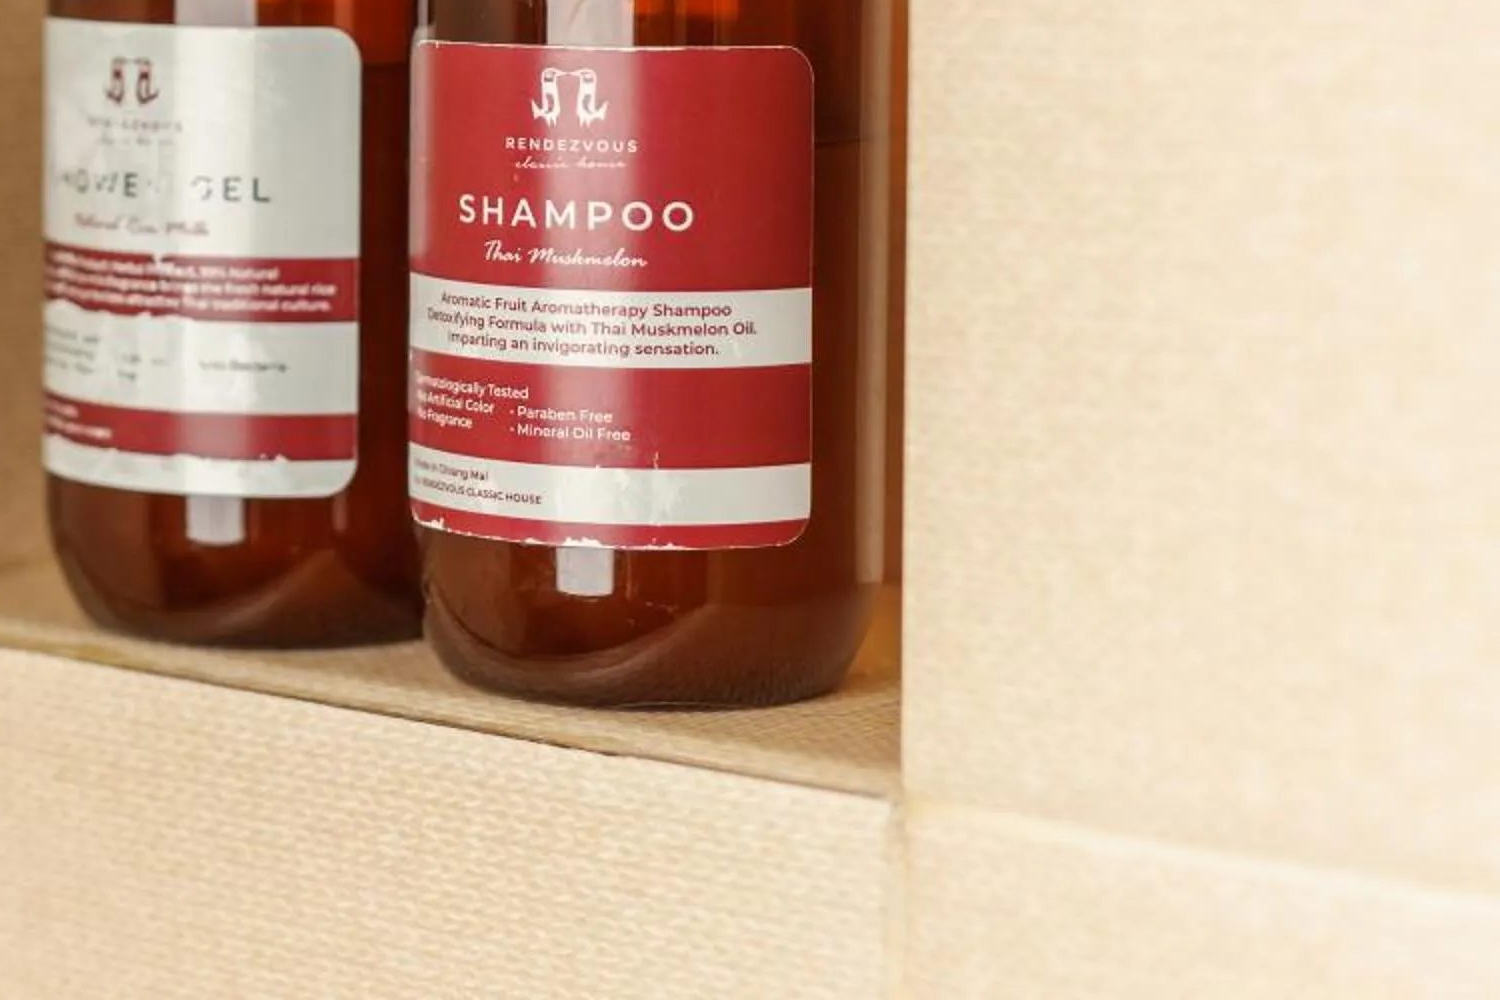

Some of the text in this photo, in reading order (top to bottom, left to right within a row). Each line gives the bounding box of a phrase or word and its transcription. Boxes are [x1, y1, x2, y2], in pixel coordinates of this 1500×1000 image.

[505, 136, 638, 153] RENDEZVOUS
[459, 193, 695, 232] SHAMPOO
[484, 239, 648, 268] Thai Muskmelon
[261, 284, 309, 297] natural
[442, 290, 732, 319] Aromatic Fruit Aromatherapy Shampoo
[427, 307, 758, 336] Detoxifying Formula with Thai Muskmelon Oil.
[510, 339, 529, 351] an
[533, 338, 630, 358] invigorating
[635, 341, 720, 356] sensation.
[487, 383, 530, 400] Tested
[465, 399, 495, 414] Color
[516, 405, 613, 423] Paraben Free
[516, 424, 632, 441] Mineral Oil Free
[470, 470, 489, 481] Mai
[505, 493, 543, 505] HOUSE
